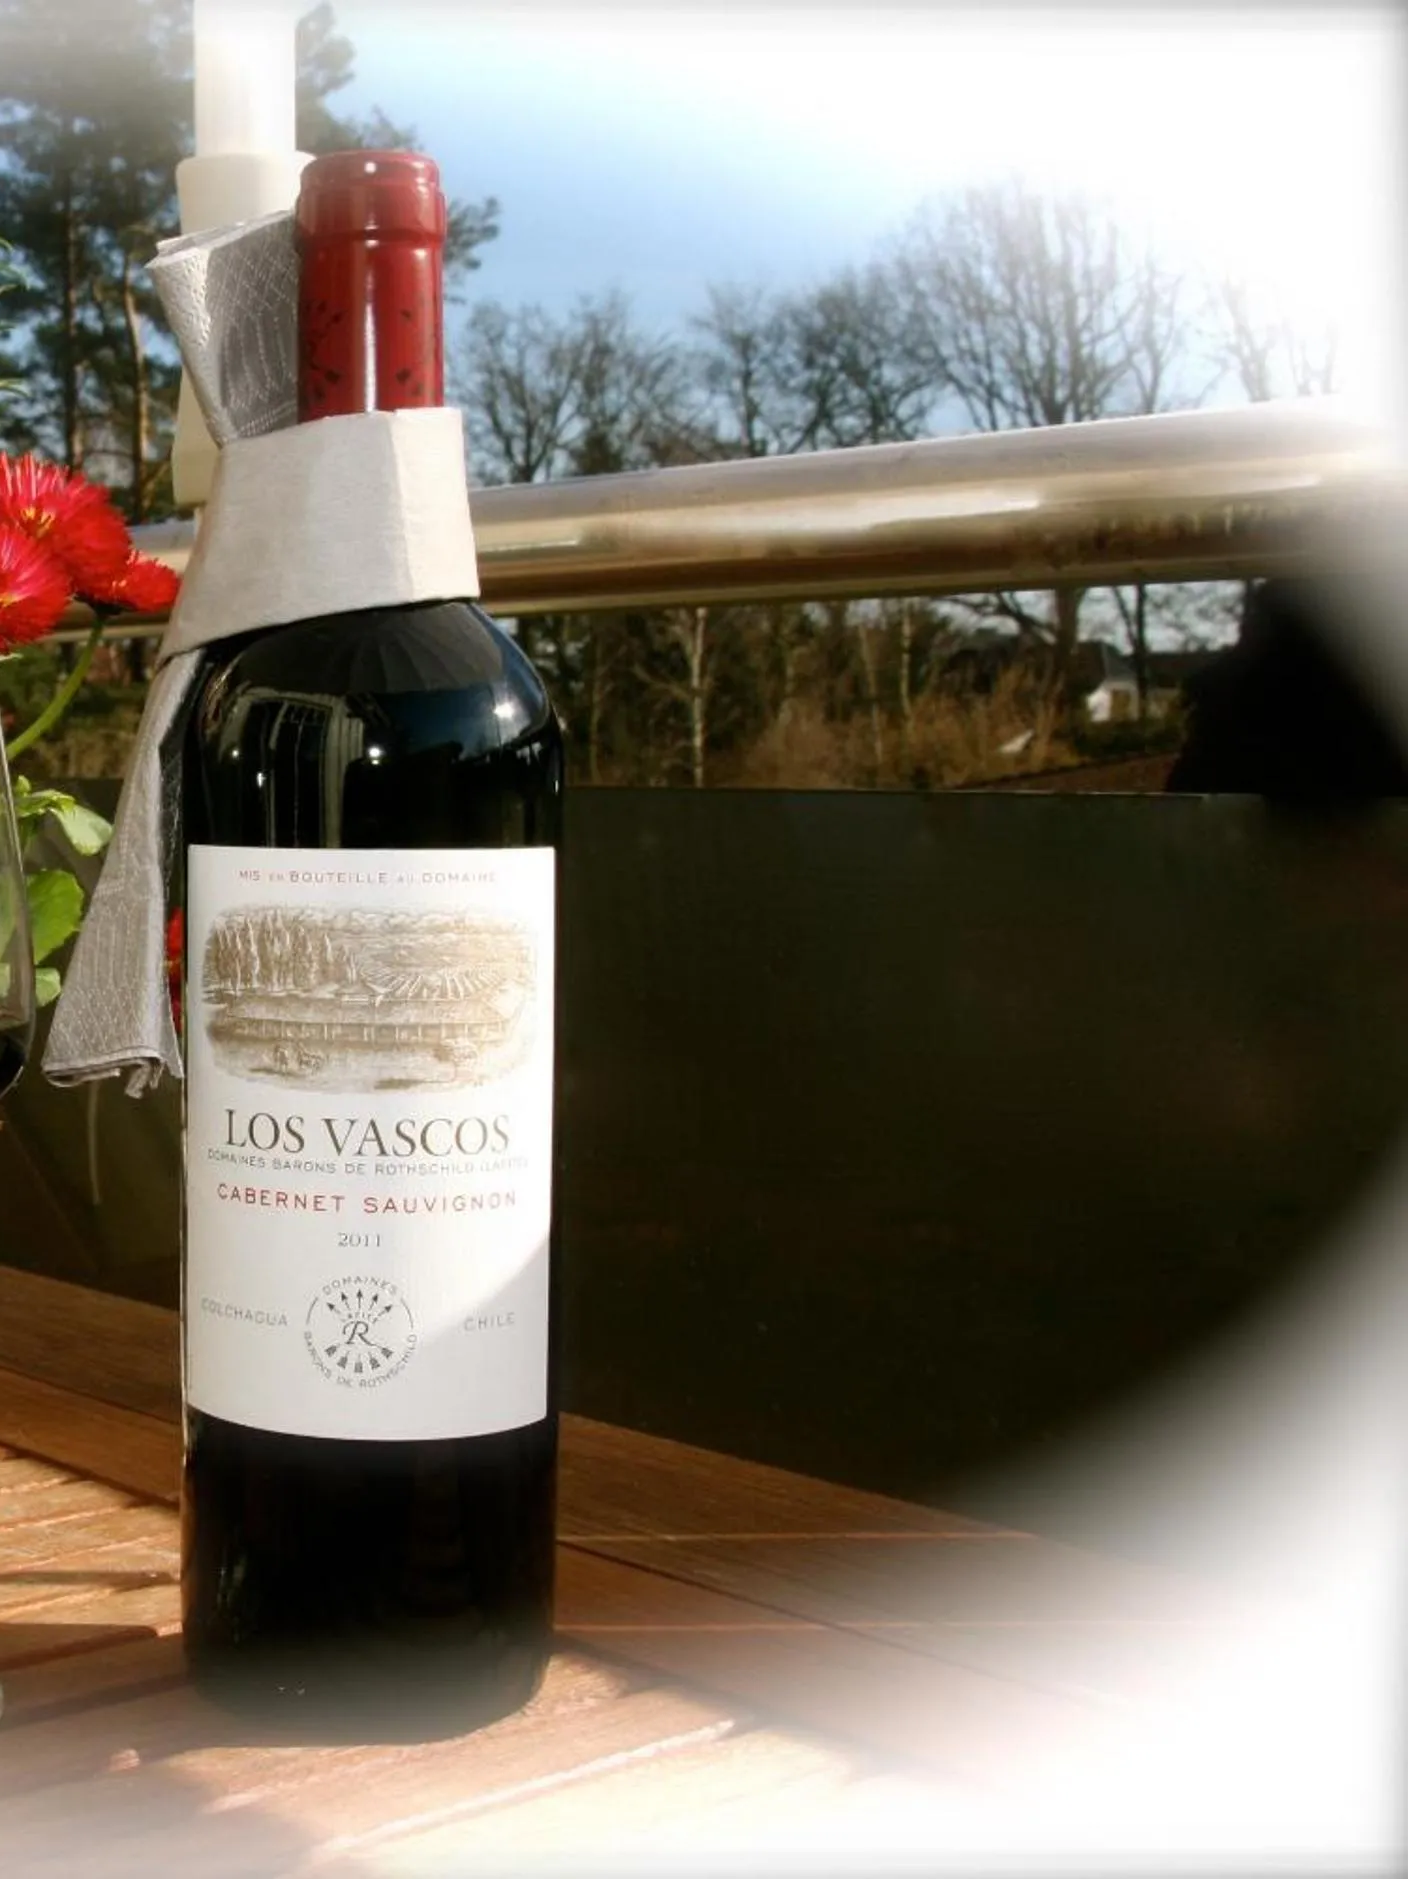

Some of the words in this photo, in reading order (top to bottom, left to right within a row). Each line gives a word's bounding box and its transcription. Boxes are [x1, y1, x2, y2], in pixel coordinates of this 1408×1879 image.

[239, 869, 261, 881] MIS
[289, 870, 388, 884] BOUTEILLE
[225, 1109, 305, 1154] LOS
[322, 1114, 510, 1157] VASCOS
[207, 1148, 266, 1170] DOMAINES
[273, 1157, 337, 1175] BARONS
[344, 1162, 366, 1176] DE
[374, 1160, 475, 1177] ROTHSCHILD
[216, 1182, 346, 1214] CABERNET
[363, 1190, 516, 1215] SAUVIGNON
[337, 1232, 382, 1249] 2011
[322, 1275, 398, 1296] DOMAINES
[200, 1297, 289, 1328] COLCHAGUA
[464, 1312, 516, 1332] CHILE
